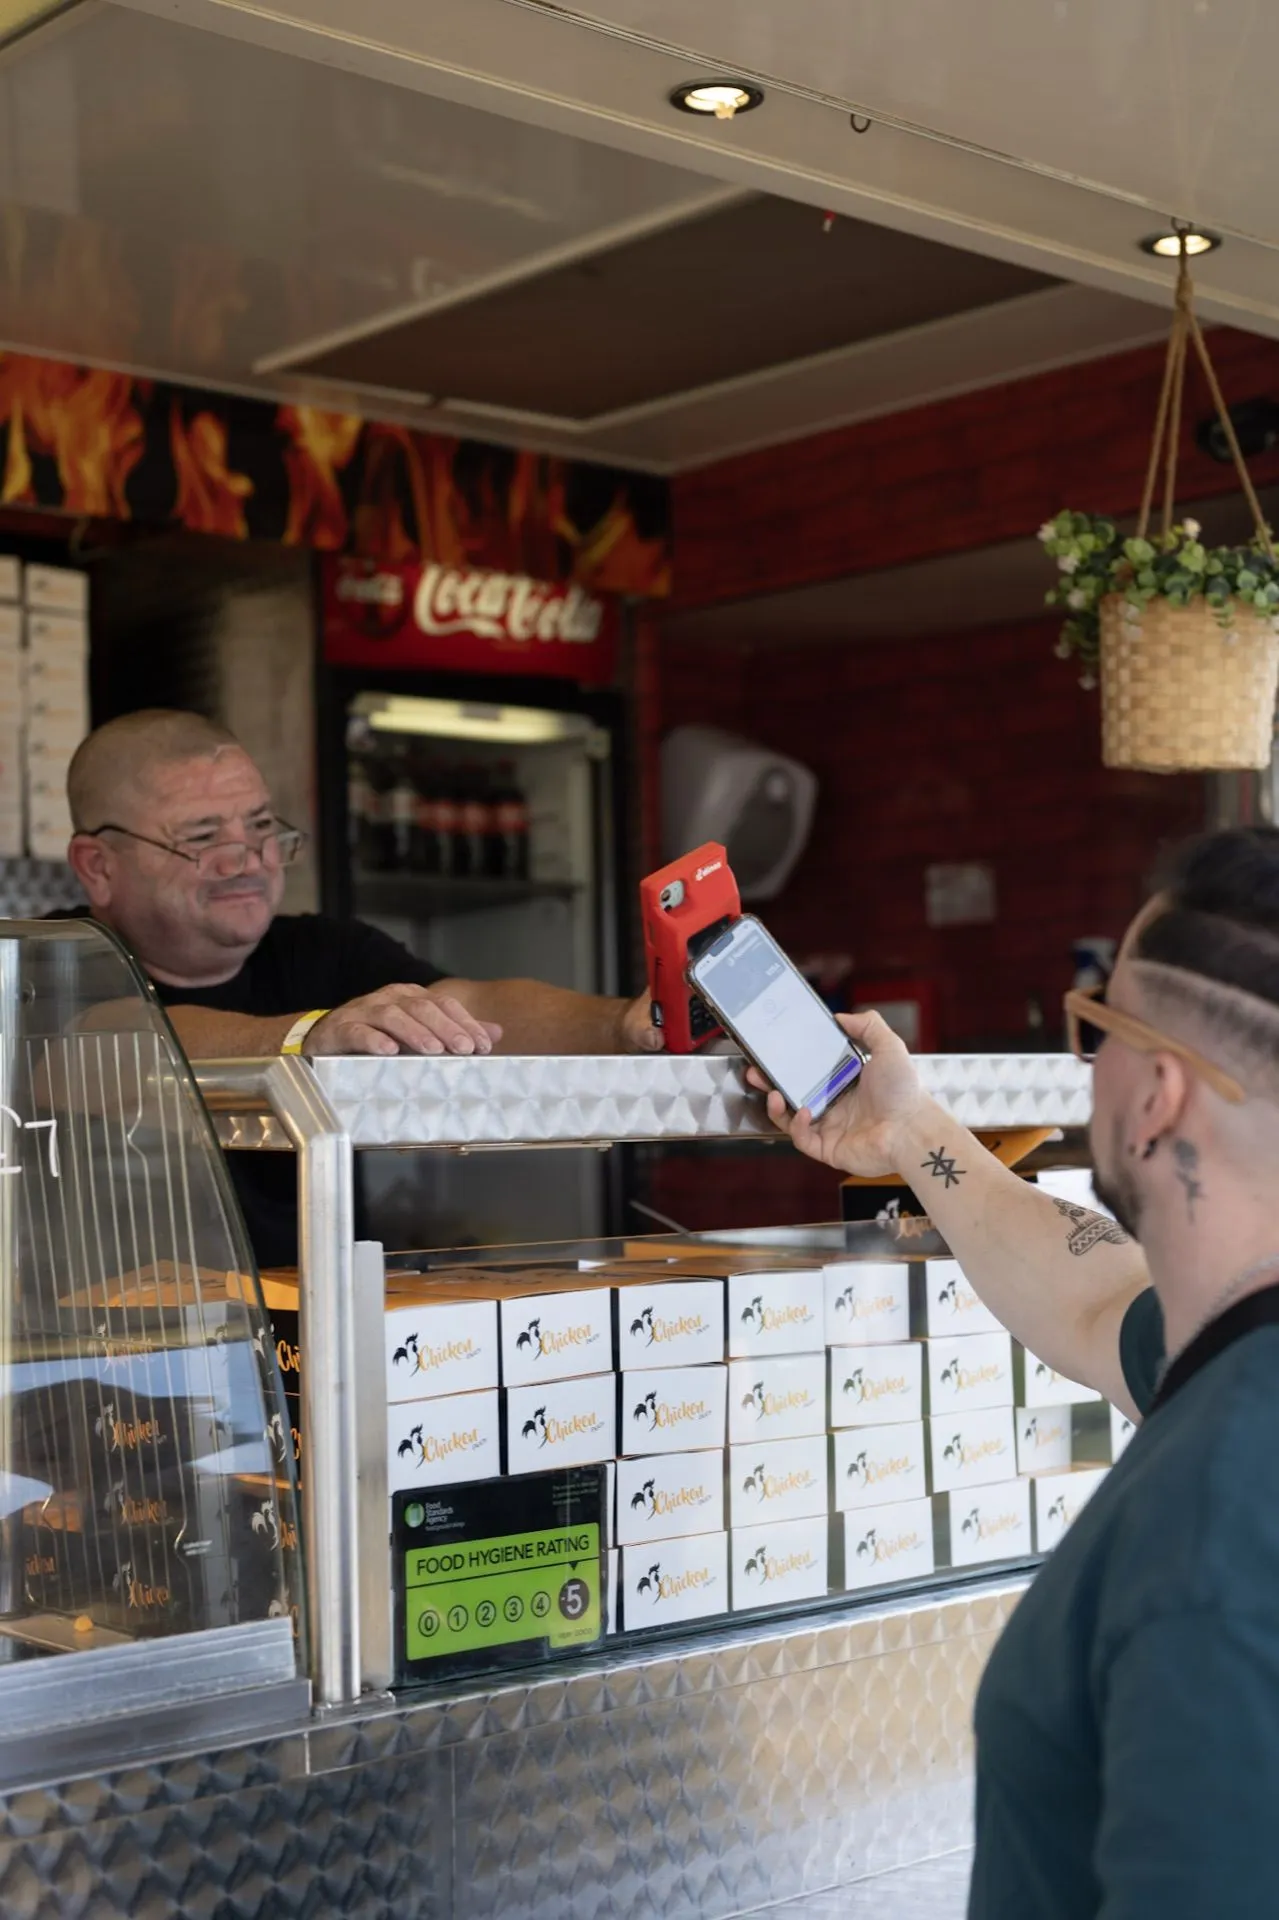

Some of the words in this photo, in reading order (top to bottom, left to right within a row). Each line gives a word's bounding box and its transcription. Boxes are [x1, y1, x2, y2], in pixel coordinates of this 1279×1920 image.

[651, 1314, 703, 1344] Chicken
[762, 1305, 808, 1332] Chicken
[419, 1337, 473, 1372] Chicken
[541, 1323, 592, 1357] Chicken
[656, 1399, 706, 1430] Chicken
[763, 1389, 809, 1417] Chicken
[546, 1411, 597, 1445] Chicken
[423, 1427, 478, 1464] Chicken
[764, 1470, 810, 1499] Chicken
[655, 1485, 705, 1516] Chicken
[416, 1553, 465, 1576] FOOD
[468, 1543, 534, 1567] HYGIENE
[536, 1534, 590, 1557] RATING
[765, 1550, 811, 1580] Chicken
[566, 1583, 582, 1615] 5
[660, 1567, 709, 1600] Chicken
